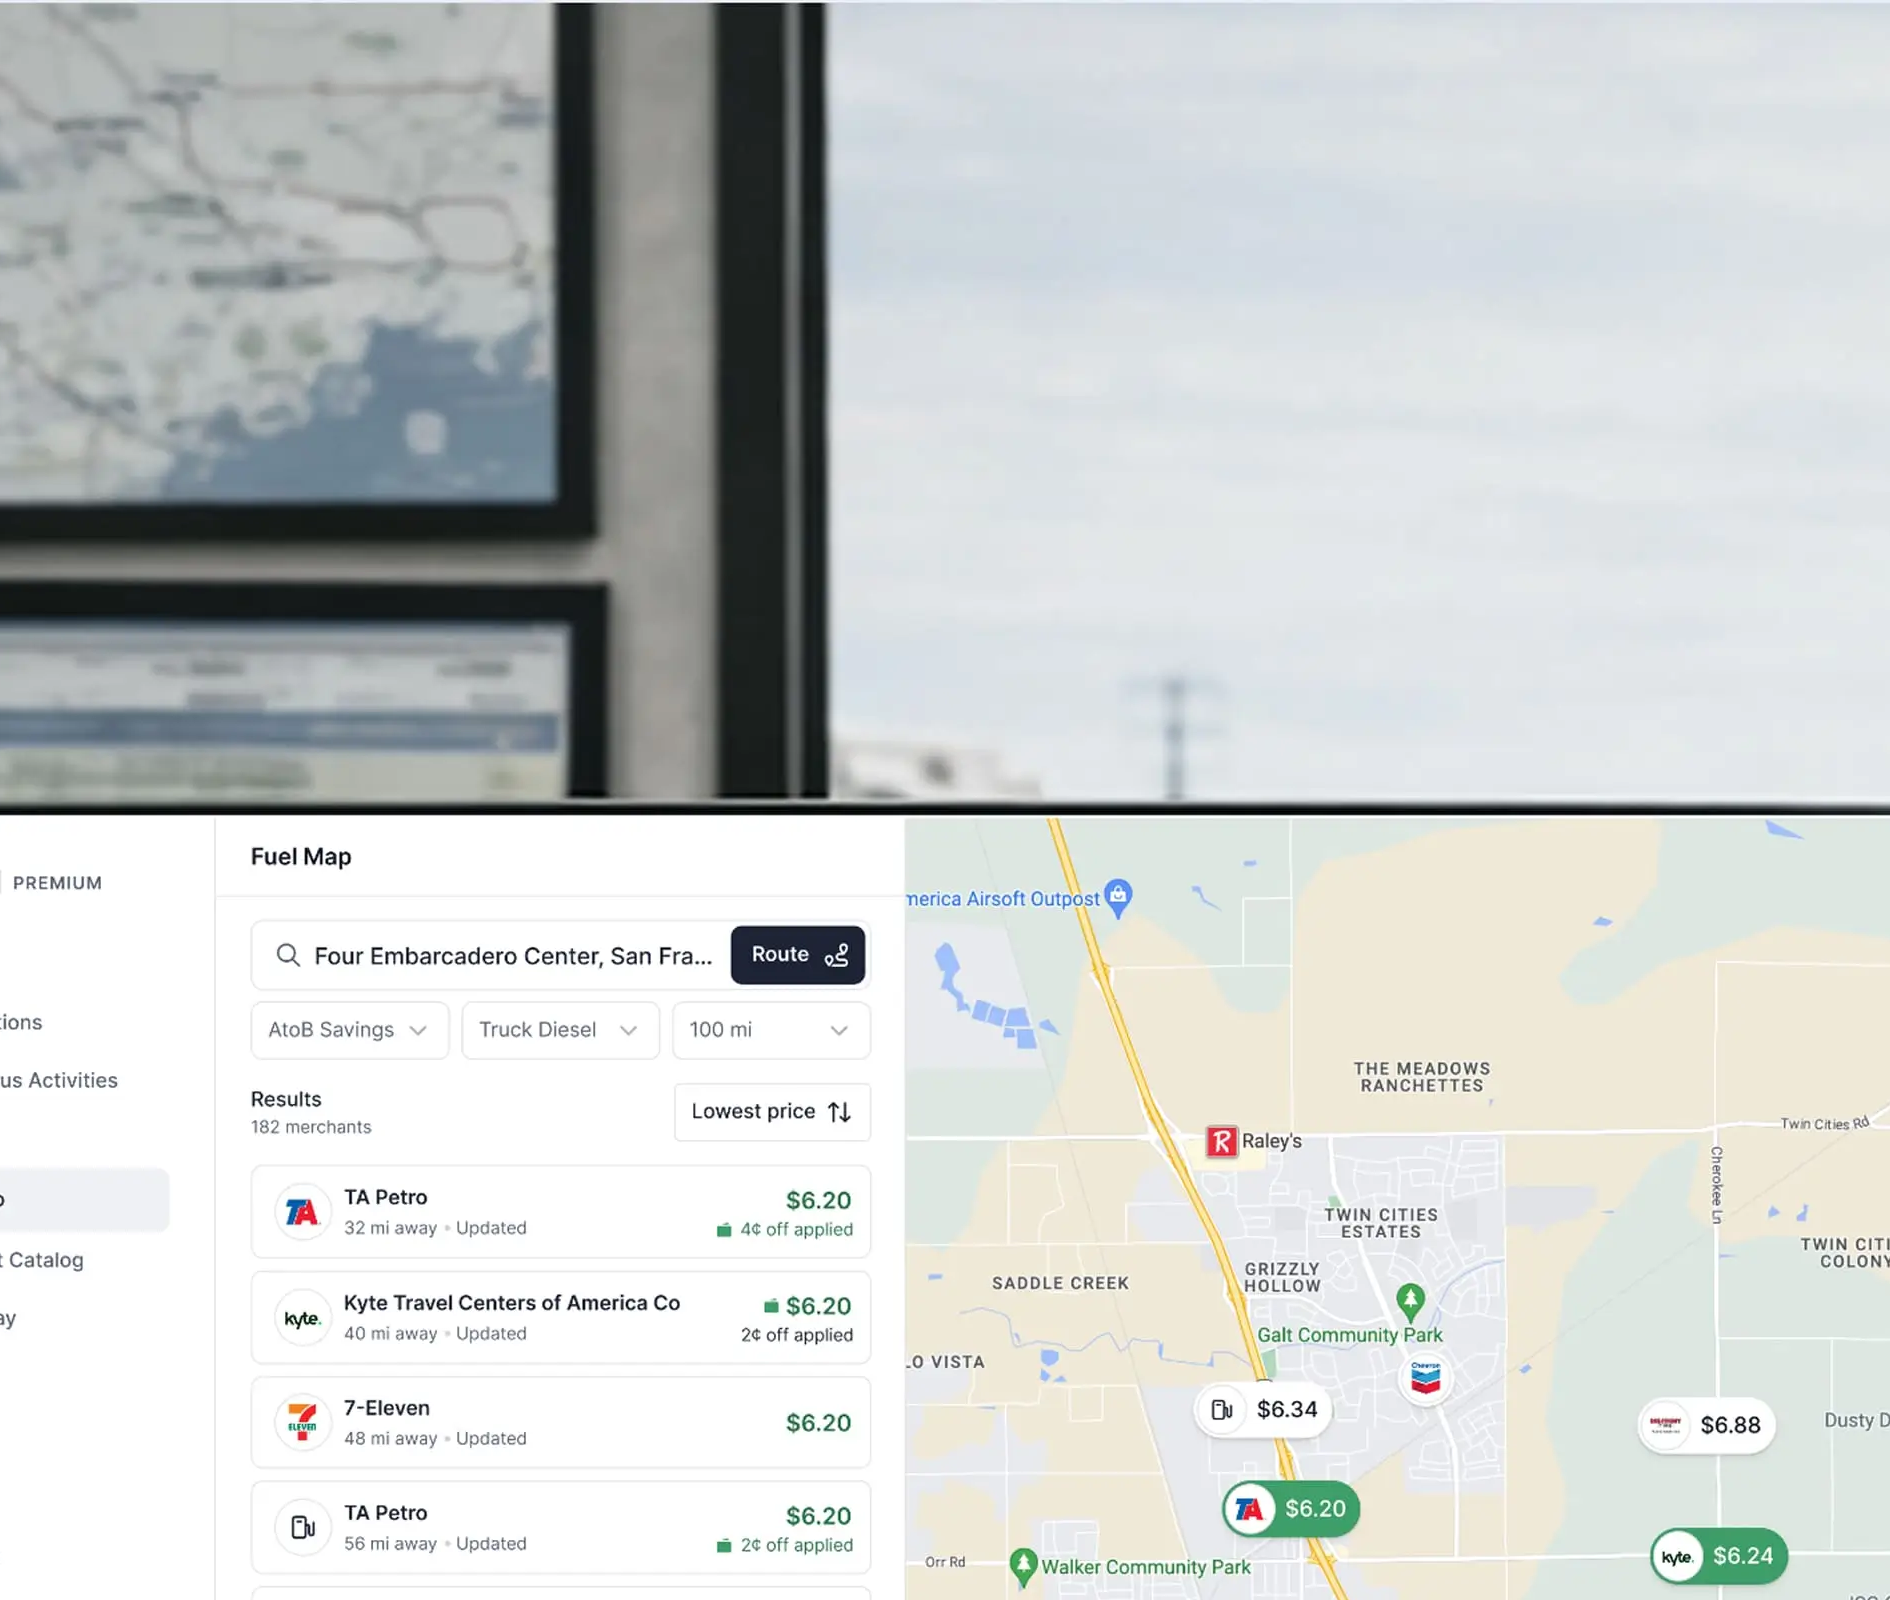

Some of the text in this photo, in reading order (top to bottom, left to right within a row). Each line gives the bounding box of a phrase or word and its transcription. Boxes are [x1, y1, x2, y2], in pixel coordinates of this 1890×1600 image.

[251, 846, 352, 871] Fuel Map
[13, 875, 102, 891] PREMIUM
[968, 890, 1025, 906] Airsoft
[1031, 891, 1100, 908] Outpost
[315, 946, 365, 966] Four
[370, 946, 518, 966] Embarcadero
[524, 946, 604, 970] Center,
[610, 946, 652, 966] San
[752, 944, 810, 963] Route
[268, 1020, 395, 1042] AtoB Savings
[479, 1020, 596, 1039] Truck Diesel
[689, 1020, 752, 1039] 100 mi
[1353, 1061, 1491, 1076] THE MEADOWS
[28, 1071, 119, 1089] Activities
[1361, 1078, 1483, 1093] RANCHETTES
[251, 1090, 323, 1108] Results
[692, 1101, 816, 1124] Lowest price
[251, 1119, 373, 1135] 182 merchants
[1780, 1115, 1870, 1131] Twin Cities Rd
[1242, 1132, 1303, 1151] Raley's
[1711, 1146, 1724, 1225] Cherokee Ln
[343, 1188, 428, 1206] TA Petro
[786, 1189, 852, 1212] $6.20
[1324, 1207, 1438, 1222] TWIN CITIES
[344, 1219, 527, 1239] 32 mi away Updated
[766, 1221, 790, 1237] off
[793, 1221, 854, 1240] applied
[1341, 1224, 1421, 1239] ESTATES
[1800, 1237, 1848, 1251] TWIN
[9, 1251, 84, 1273] Catalog
[1244, 1262, 1320, 1276] GRIZZLY
[992, 1276, 1129, 1290] SADDLE CREEK
[1244, 1278, 1321, 1293] HOLLOW
[344, 1293, 681, 1315] Kyte Travel Centers of America Co
[786, 1295, 852, 1317] $6.20
[1257, 1326, 1444, 1347] Galt Community Park
[343, 1399, 430, 1417] 7-Eleven
[1256, 1398, 1318, 1421] $6.34
[785, 1412, 852, 1434] $6.20
[1700, 1415, 1762, 1436] $6.88
[1825, 1412, 1875, 1432] Dusty
[343, 1504, 428, 1522] TA Petro
[786, 1505, 852, 1527] $6.20
[1285, 1498, 1347, 1519] $6.20
[1713, 1545, 1774, 1566] $6.24
[1041, 1557, 1251, 1579] Walker Community Park
